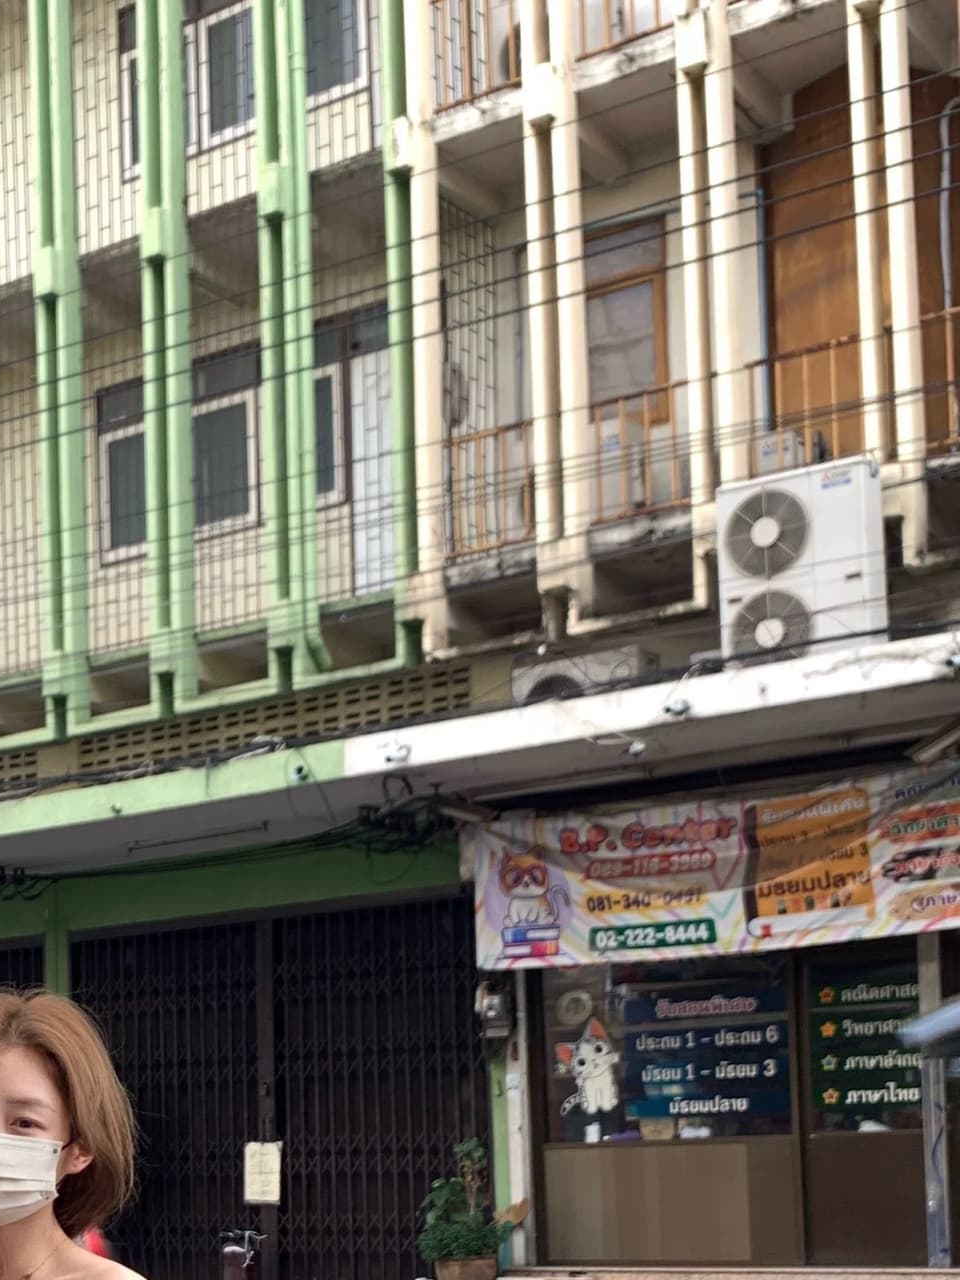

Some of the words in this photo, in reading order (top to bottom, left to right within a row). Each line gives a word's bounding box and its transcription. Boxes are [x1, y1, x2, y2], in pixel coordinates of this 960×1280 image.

[595, 922, 710, 949] 02-222-8444
[636, 1034, 681, 1051] ประถม
[685, 1030, 696, 1049] 1
[714, 1028, 763, 1047] ประถม
[765, 1024, 780, 1044] 6
[685, 1063, 696, 1081] 1
[762, 1058, 778, 1078] 3
[844, 1081, 921, 1105] ภาษาไทย
[668, 1096, 750, 1115] มัธยมปลาย
